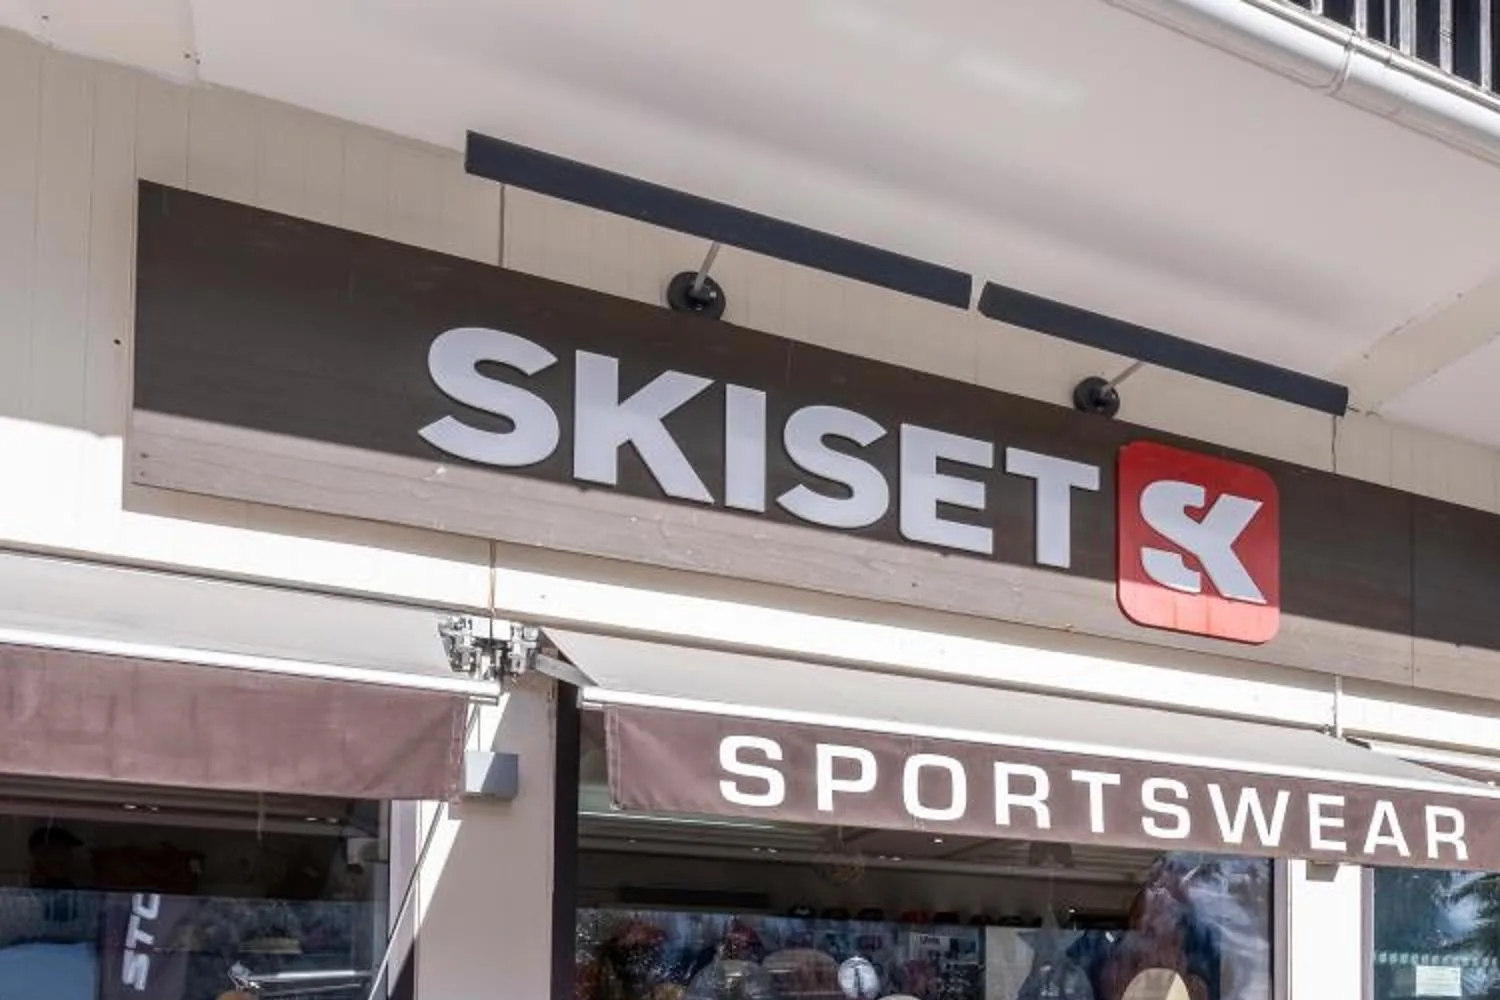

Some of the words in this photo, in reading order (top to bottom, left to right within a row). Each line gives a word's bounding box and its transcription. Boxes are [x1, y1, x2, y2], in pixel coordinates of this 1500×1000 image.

[418, 326, 1100, 569] SKISET
[1138, 479, 1269, 604] SK
[718, 735, 1468, 861] SPORTSWEAR
